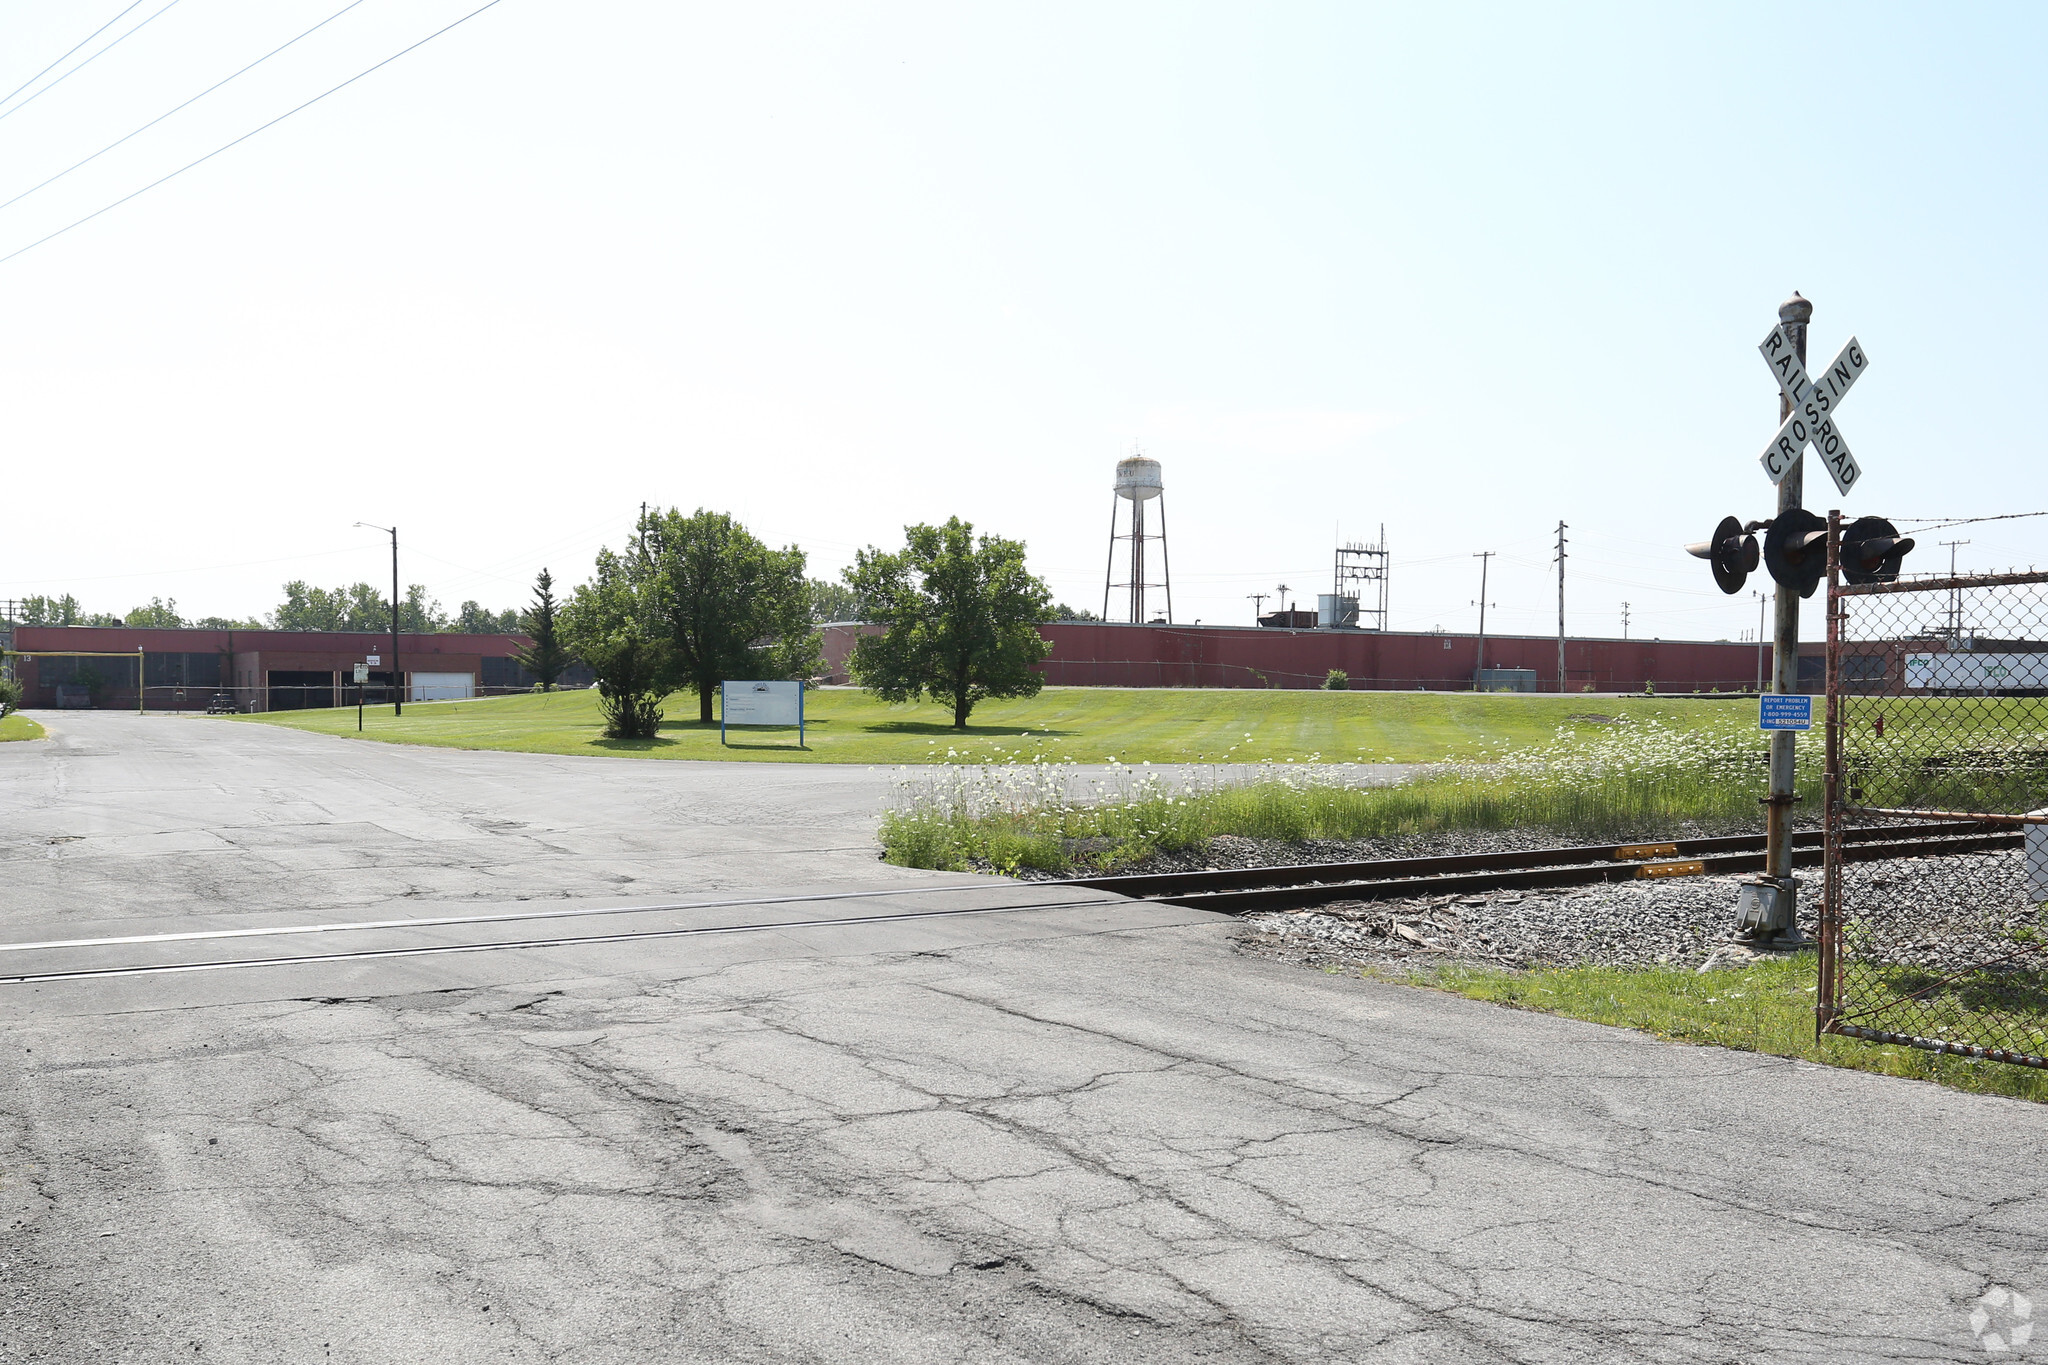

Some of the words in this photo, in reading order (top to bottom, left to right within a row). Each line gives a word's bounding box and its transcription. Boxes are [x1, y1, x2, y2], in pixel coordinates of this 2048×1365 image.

[1767, 346, 1863, 475] CROSSING
[1909, 659, 1929, 667] IFCO
[1984, 666, 2007, 677] IFCO
